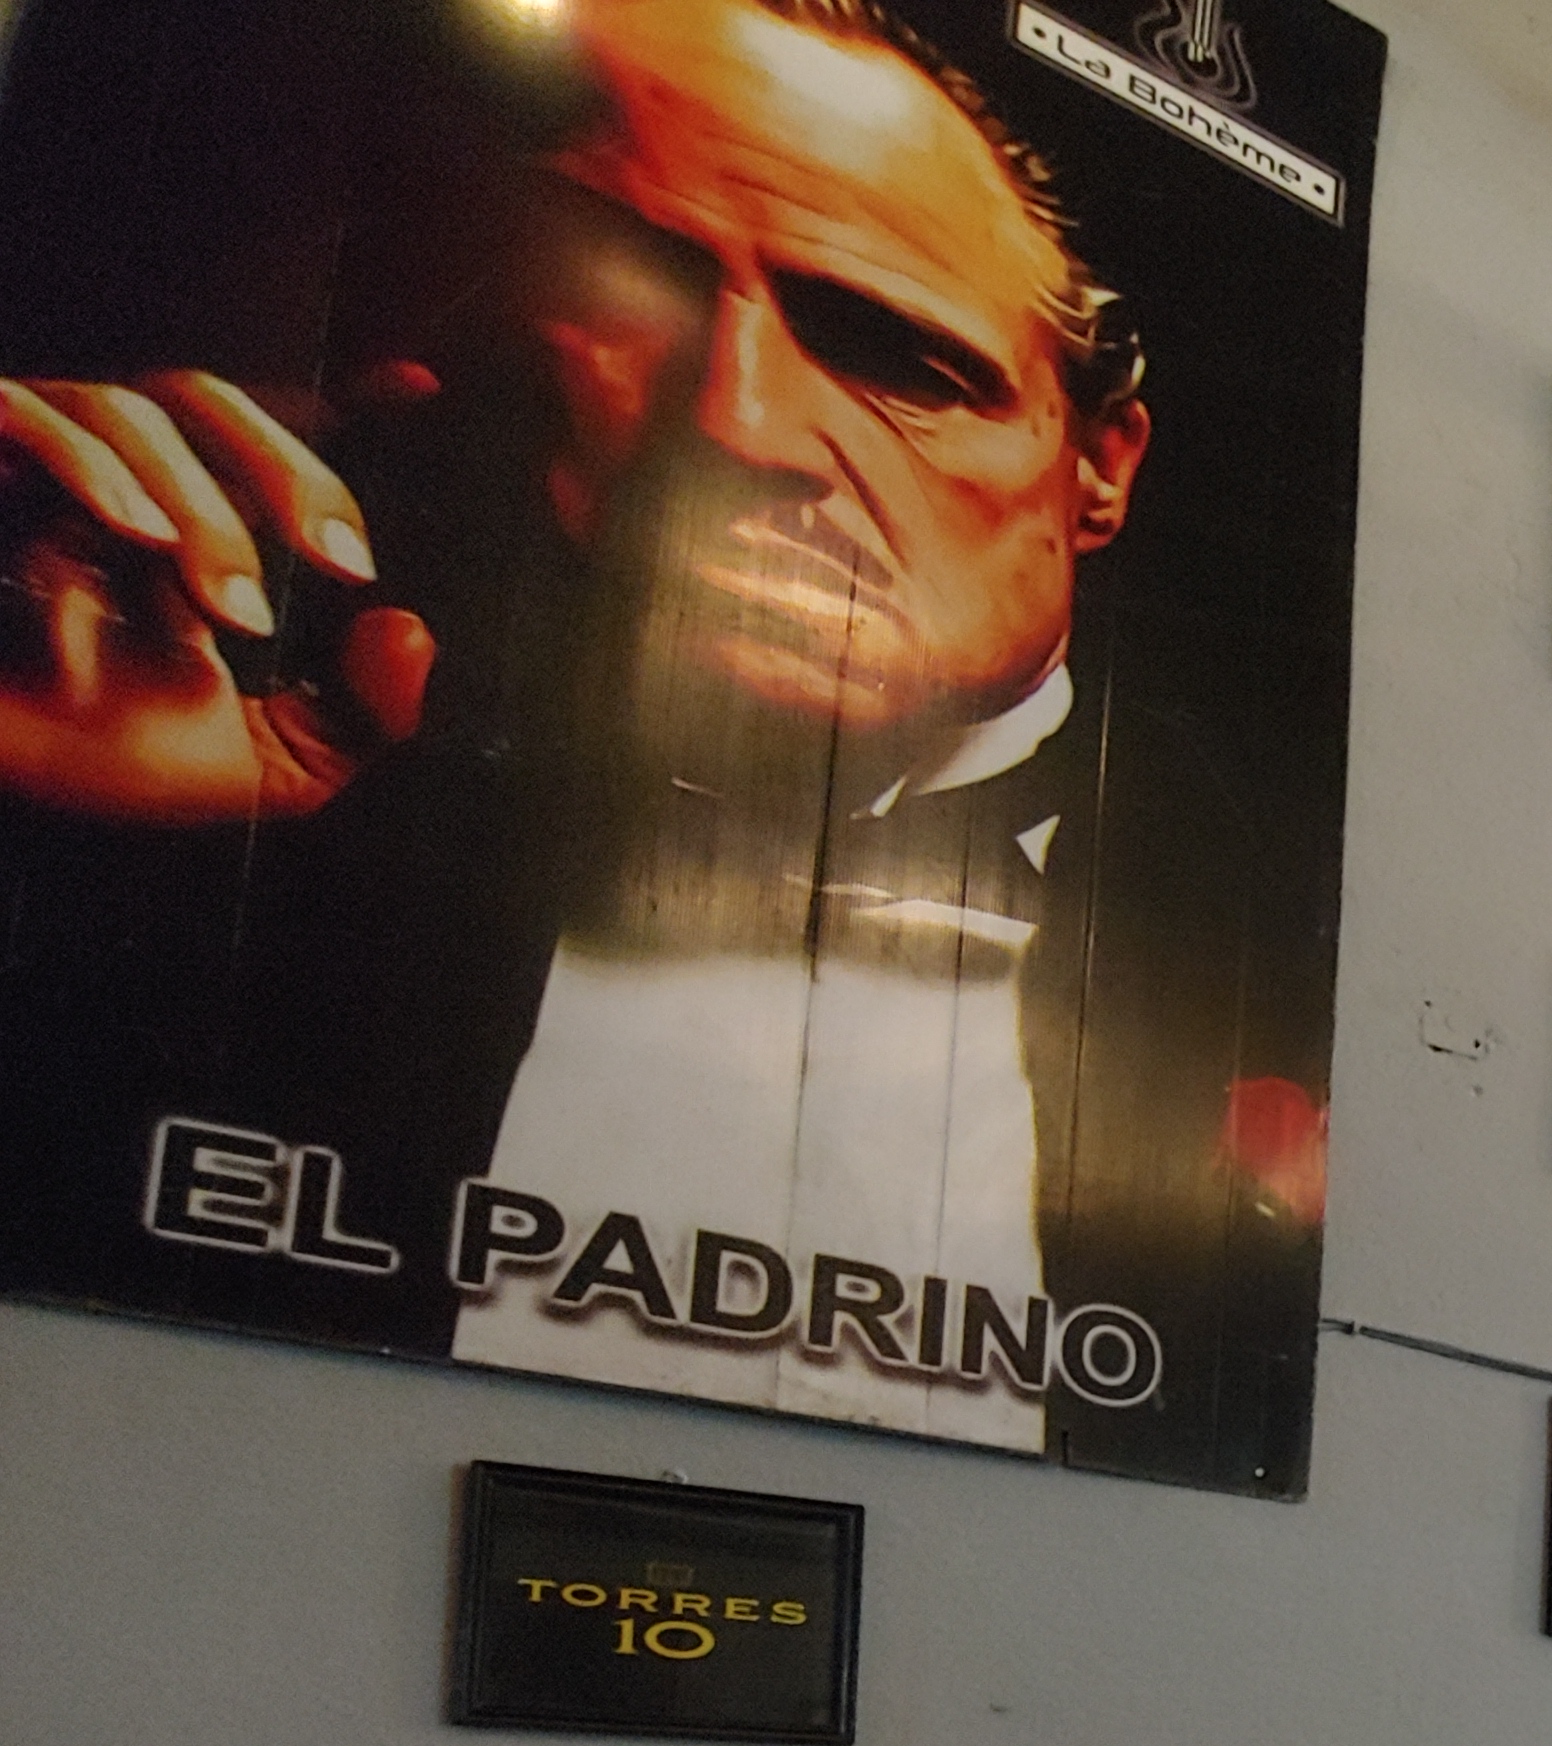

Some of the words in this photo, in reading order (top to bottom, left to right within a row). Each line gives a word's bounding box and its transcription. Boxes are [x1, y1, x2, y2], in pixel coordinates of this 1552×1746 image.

[1056, 33, 1112, 80] La
[1127, 73, 1303, 184] Bohème
[142, 1116, 400, 1273] EL
[449, 1175, 1164, 1408] PADRINO
[517, 1577, 808, 1626] TORRES
[613, 1618, 716, 1660] 10
